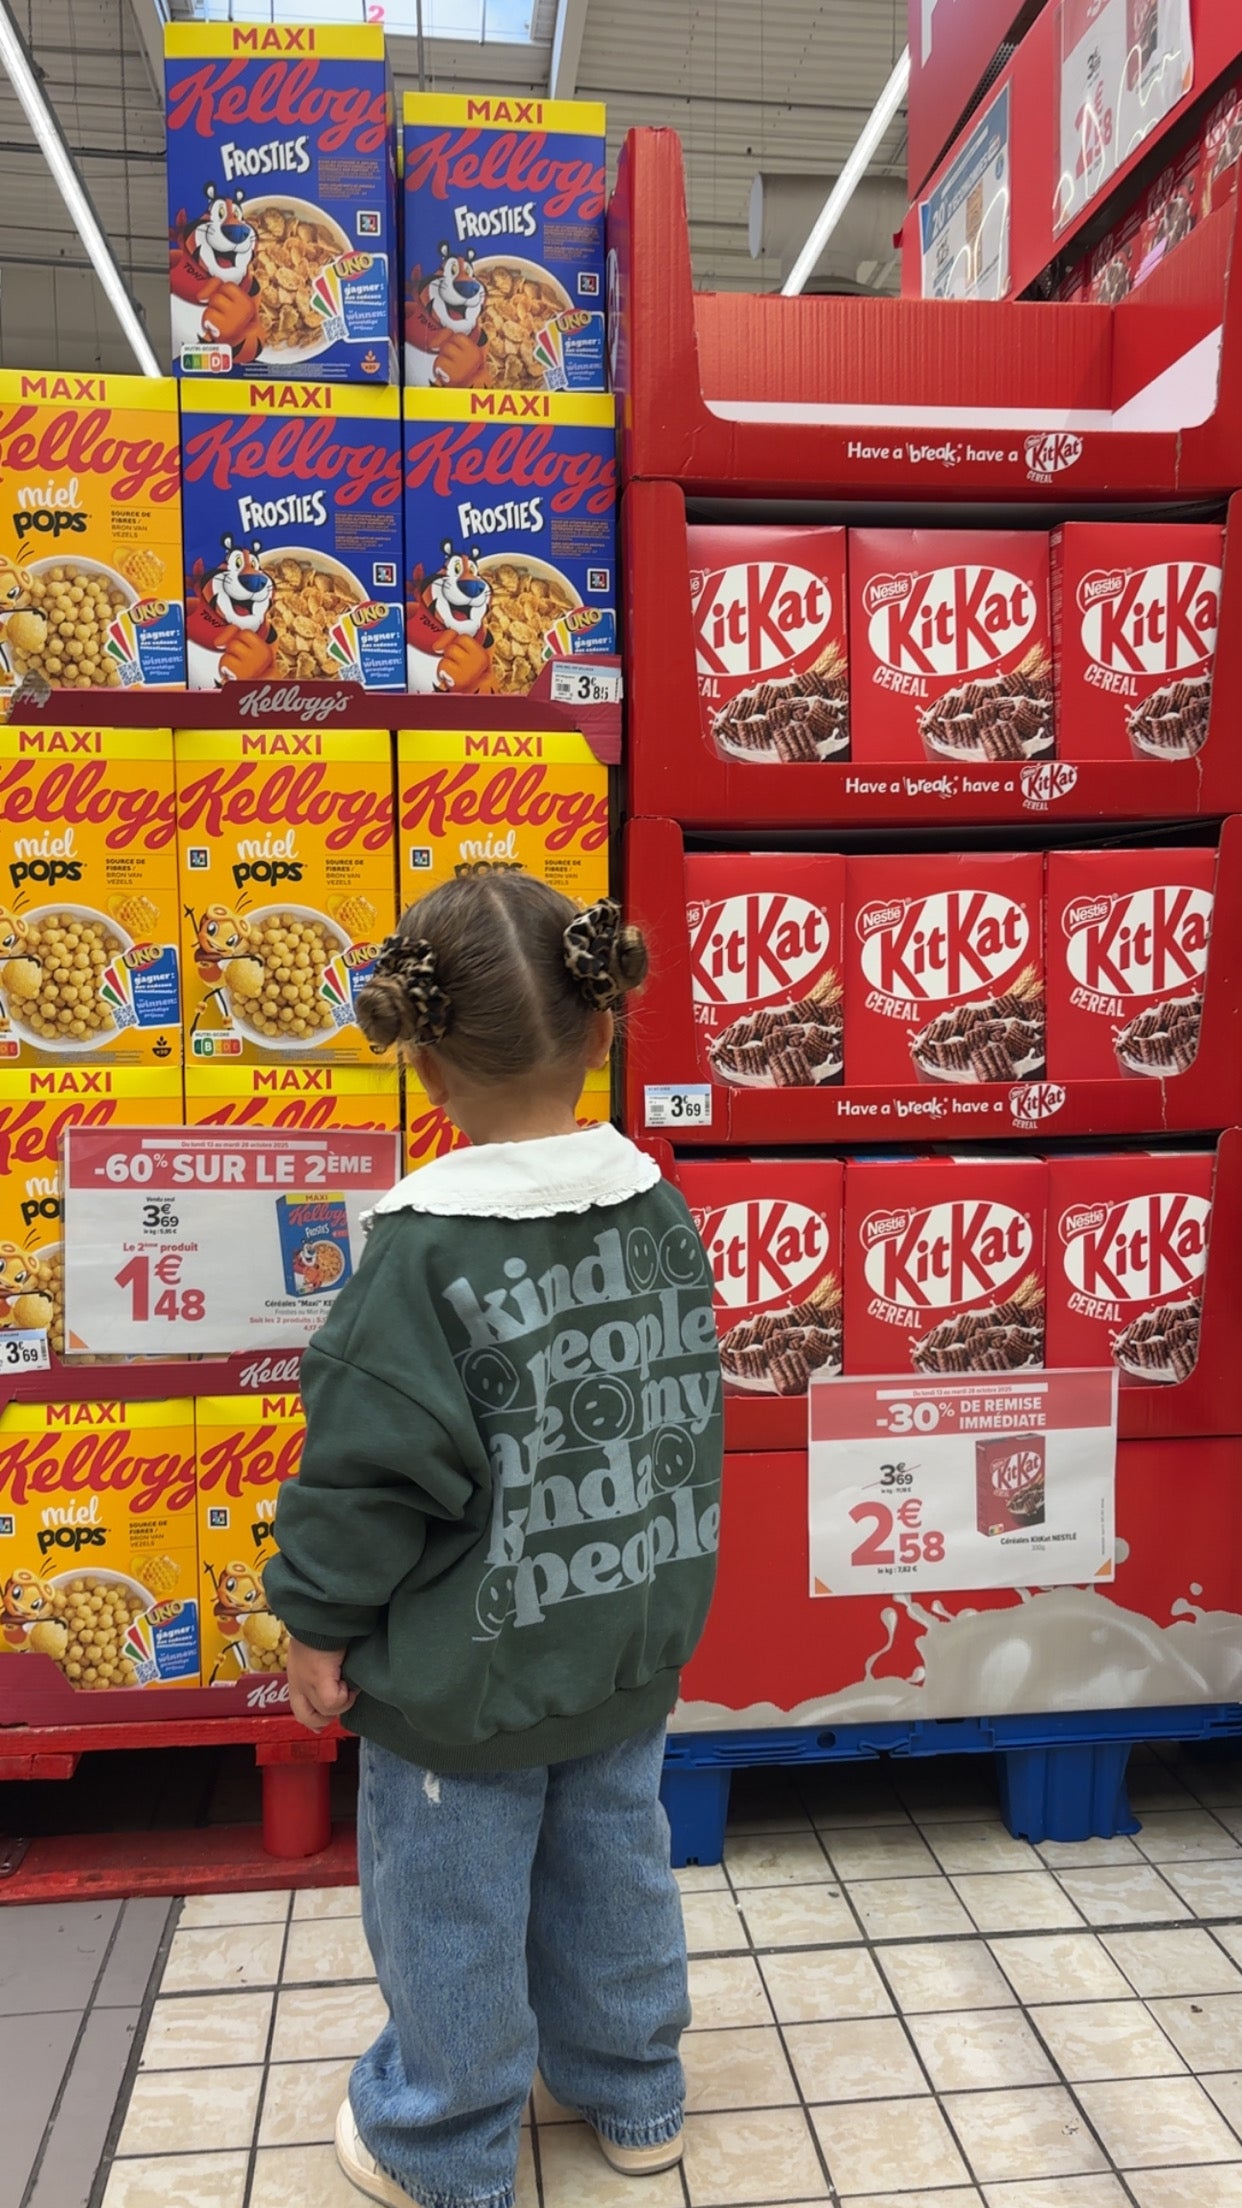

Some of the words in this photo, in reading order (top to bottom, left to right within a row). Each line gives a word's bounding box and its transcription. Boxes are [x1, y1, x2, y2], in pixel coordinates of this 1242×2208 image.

[233, 28, 315, 50] MAXI
[468, 100, 542, 124] MAXI
[221, 137, 309, 181] FROSTIES
[455, 202, 536, 241] FROSTIES
[333, 253, 373, 278] UNO
[556, 312, 592, 332] UNO
[21, 376, 105, 401] MAXI
[250, 385, 331, 408] MAXI
[471, 394, 549, 417] MAXI
[848, 442, 889, 459] Have
[893, 446, 902, 459] a
[966, 445, 1003, 462] have
[1008, 451, 1018, 461] a
[1032, 434, 1080, 471] KitKat
[1026, 471, 1053, 483] CEREAL
[18, 477, 83, 509] miel
[13, 509, 88, 539] pops
[238, 490, 326, 532] FROSTIES
[458, 497, 543, 538] FROSTIES
[128, 601, 169, 624] UNO
[350, 603, 389, 626] UNO
[420, 615, 444, 632] TONY
[565, 608, 602, 632] UNO
[888, 568, 1029, 674] KitKat
[1101, 564, 1218, 672] KitKa
[873, 666, 929, 697] CEREAL
[1084, 664, 1138, 696] CEREAL
[239, 685, 347, 721] Kellogg's
[19, 731, 101, 752] MAXI
[242, 734, 321, 755] MAXI
[465, 736, 542, 757] MAXI
[846, 778, 886, 793] Have
[890, 782, 899, 793] a
[963, 777, 999, 792] have
[1004, 781, 1014, 791] a
[1028, 764, 1075, 799] KitKat
[1022, 800, 1048, 811] CEREAL
[14, 828, 77, 858] miel
[237, 828, 298, 859] miel
[459, 830, 518, 860] miel
[9, 859, 82, 888] pops
[232, 860, 303, 889] pops
[881, 893, 1021, 998] KitKat
[1087, 889, 1211, 994] KitKa
[123, 945, 164, 969] UNO
[342, 945, 380, 969] UNO
[865, 991, 920, 1022] CEREAL
[1069, 987, 1125, 1017] CEREAL
[30, 1072, 112, 1093] MAXI
[253, 1069, 332, 1090] MAXI
[837, 1101, 877, 1116] Have
[881, 1105, 890, 1115] a
[952, 1098, 989, 1113] have
[994, 1103, 1002, 1112] a
[1016, 1085, 1063, 1119] KitKat
[1012, 1119, 1037, 1129] CEREAL
[95, 1153, 168, 1182] -60%
[172, 1154, 246, 1183] SUR
[256, 1155, 295, 1183] LE
[304, 1151, 372, 1183] 2ÈME
[123, 1243, 135, 1251] Le
[160, 1242, 198, 1253] produit
[884, 1203, 1026, 1305] KitKat
[442, 1227, 631, 1348] kind
[867, 1299, 922, 1329] CEREAL
[1067, 1292, 1122, 1322] CEREAL
[526, 1287, 718, 1422] people
[47, 1403, 125, 1425] MAXI
[641, 1370, 721, 1435] my
[876, 1402, 955, 1433] -30%
[960, 1400, 980, 1412] DE
[985, 1397, 1042, 1412] REMISE
[960, 1410, 1046, 1429] IMMÉDIATE
[997, 1452, 1040, 1489] KitKat
[41, 1495, 102, 1527] miel
[37, 1527, 108, 1555] pops
[1001, 1537, 1029, 1545] Céréales
[513, 1487, 720, 1627] people
[145, 1601, 184, 1626] UNO
